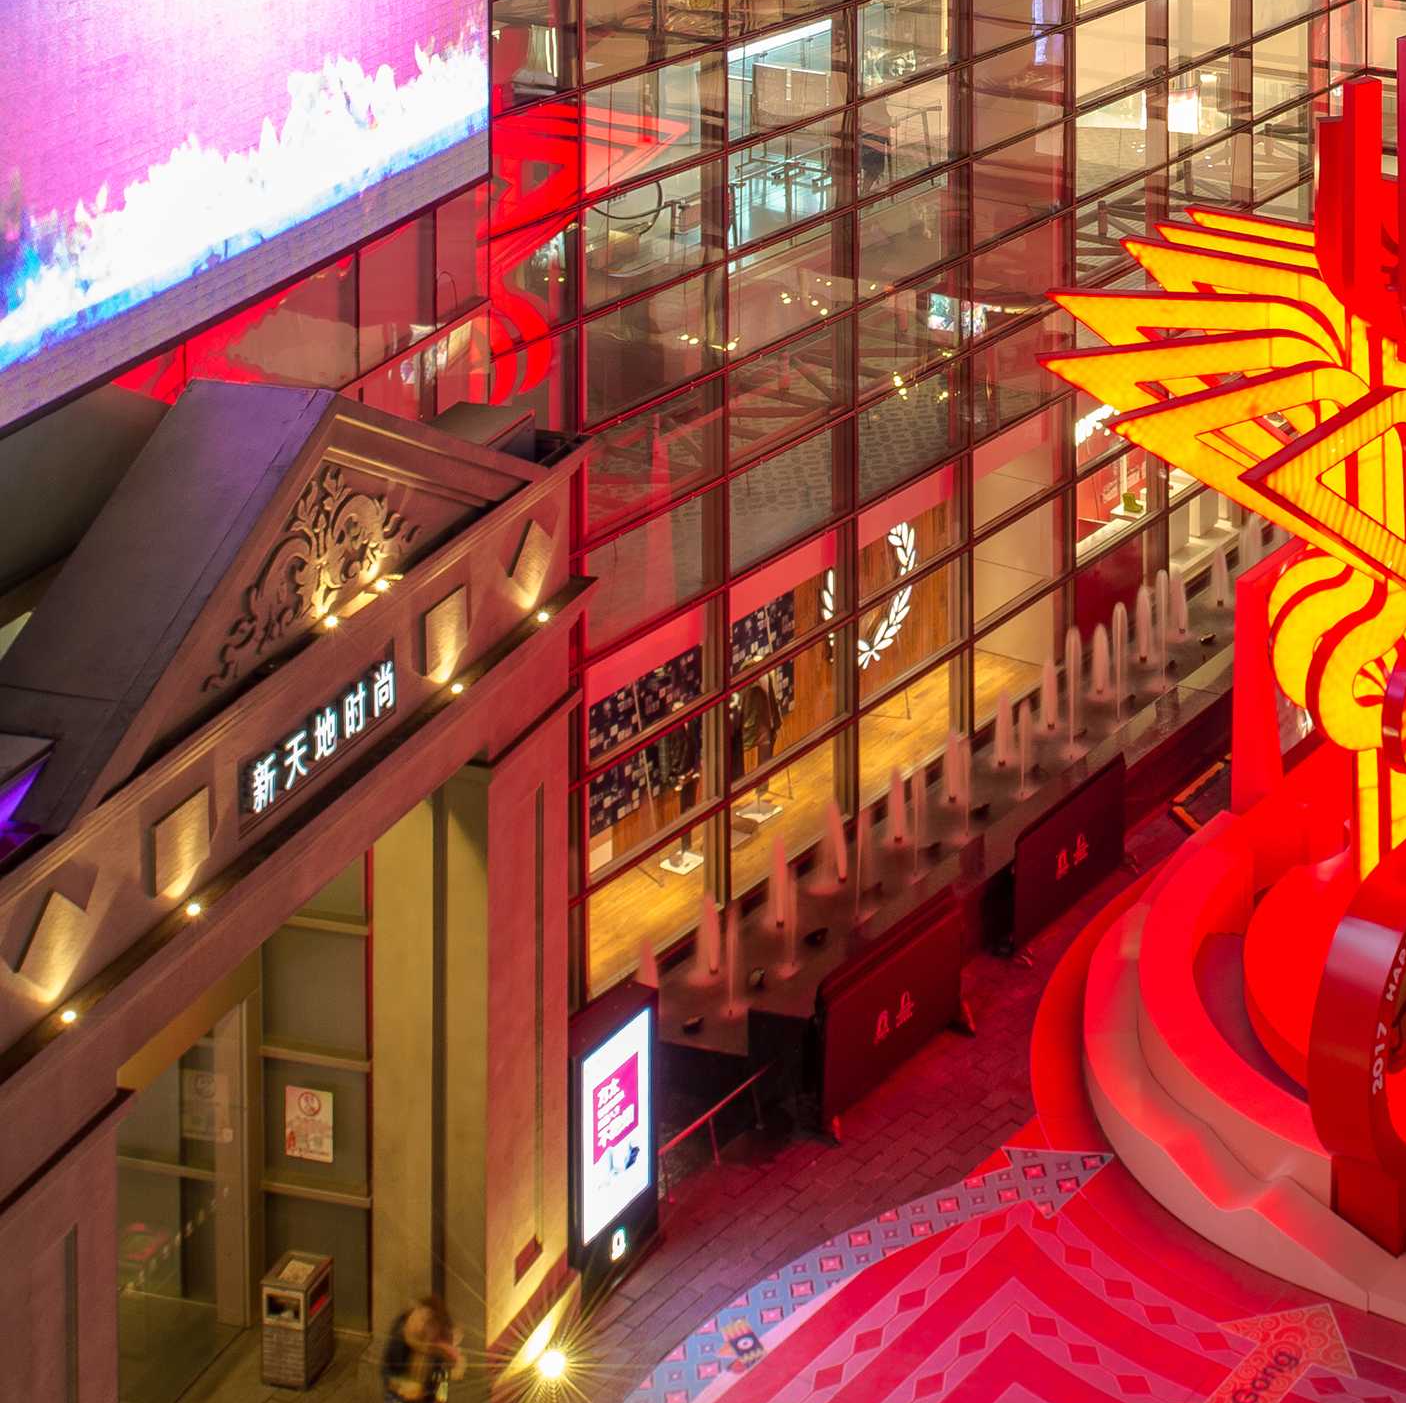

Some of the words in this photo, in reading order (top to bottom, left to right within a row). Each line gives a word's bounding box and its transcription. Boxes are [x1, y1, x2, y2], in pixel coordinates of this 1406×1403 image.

[252, 660, 395, 813] 新天地时尚
[1372, 1022, 1387, 1095] 2017
